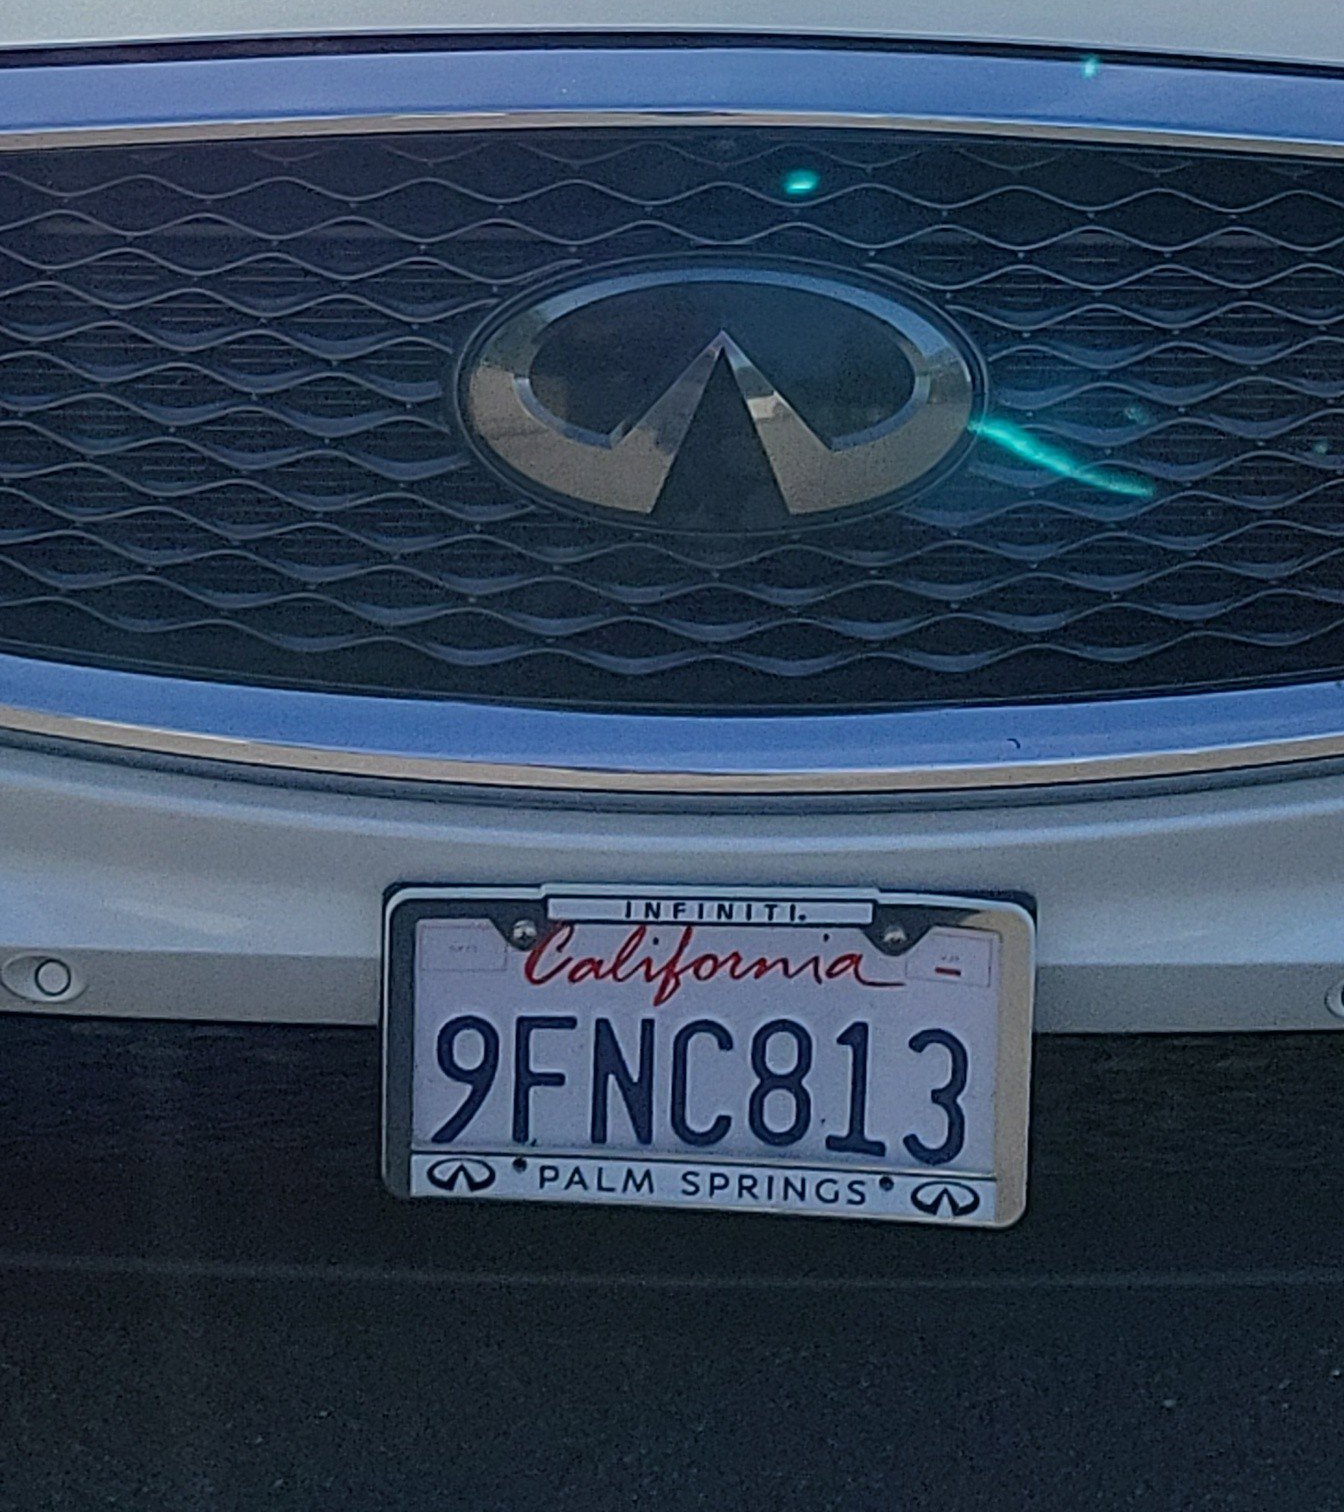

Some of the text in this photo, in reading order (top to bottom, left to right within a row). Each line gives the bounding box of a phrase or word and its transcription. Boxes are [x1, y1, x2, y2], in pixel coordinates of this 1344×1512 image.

[524, 922, 905, 1007] California
[431, 1015, 969, 1166] 9FNC813
[537, 1164, 868, 1206] PALM SPRINGS
